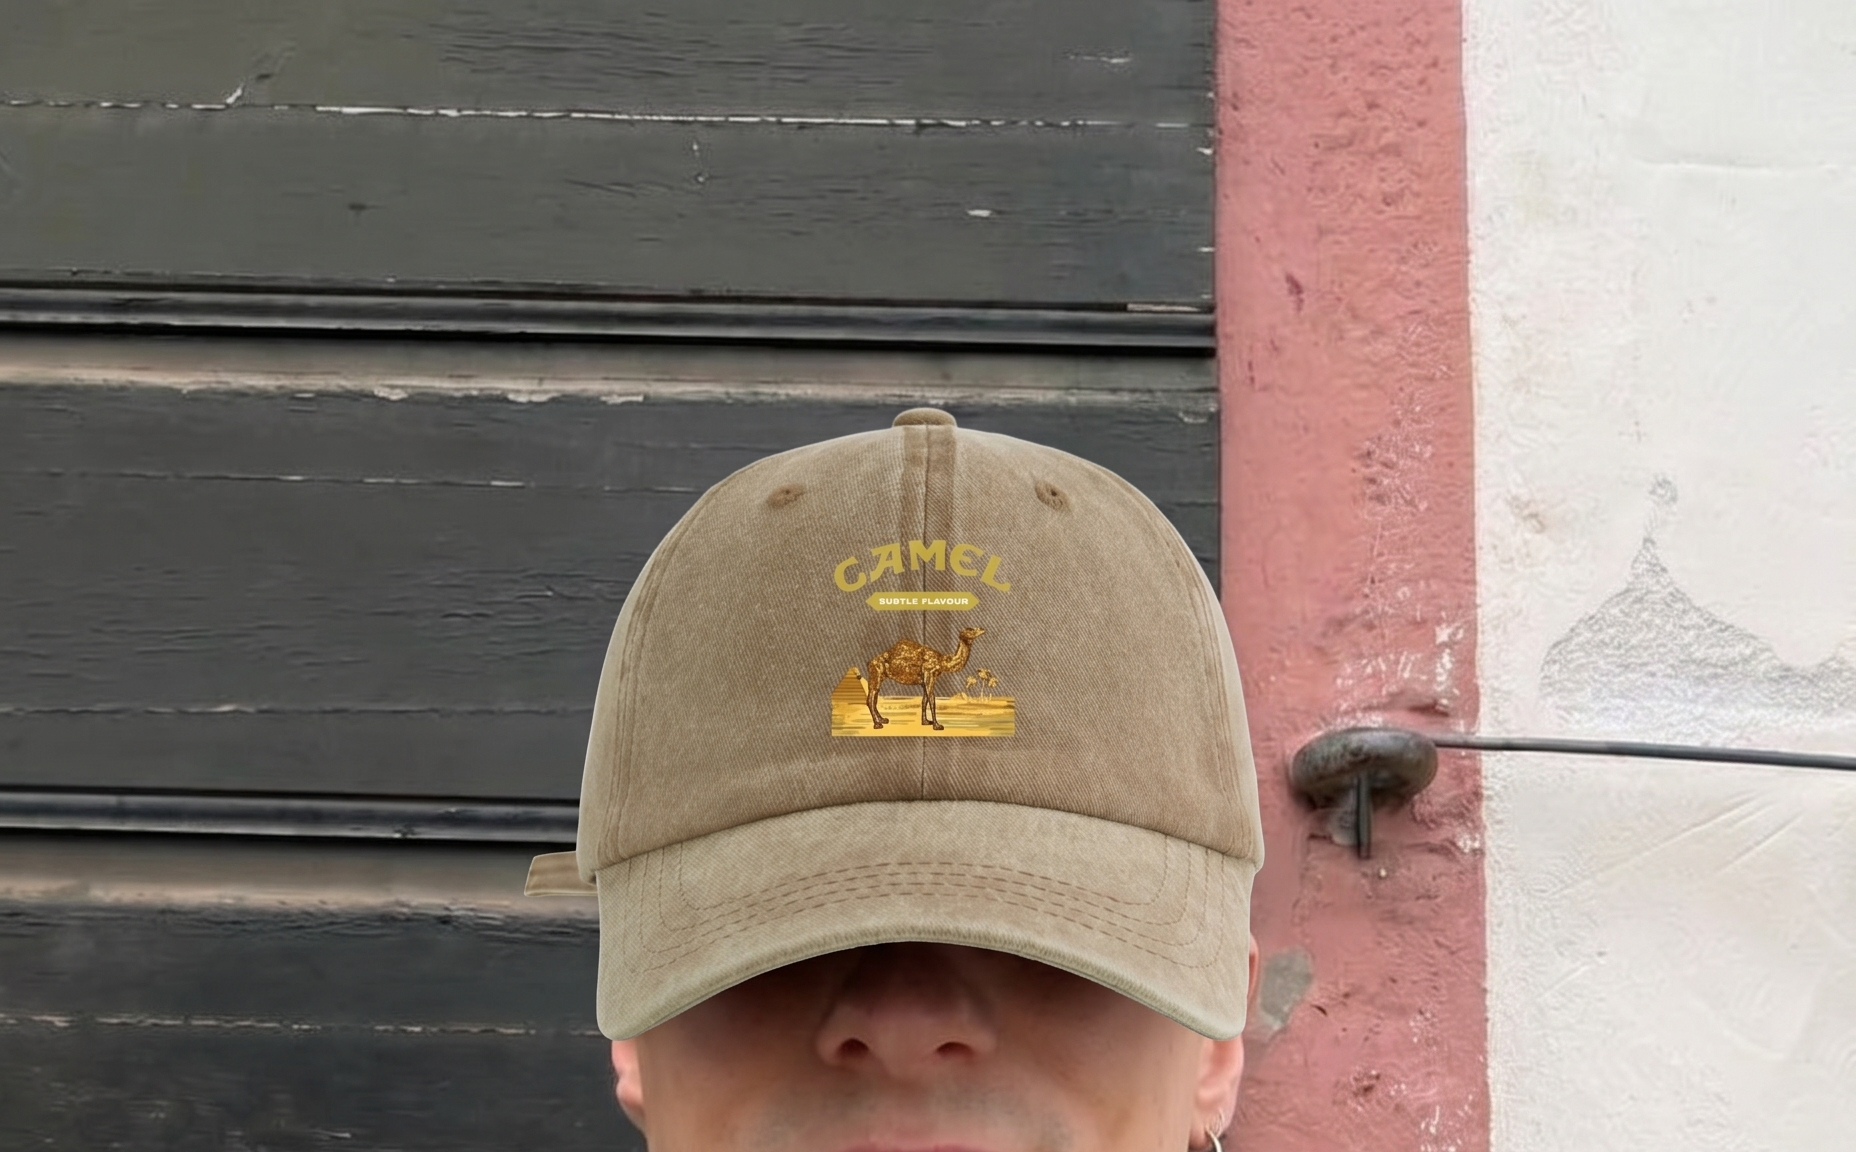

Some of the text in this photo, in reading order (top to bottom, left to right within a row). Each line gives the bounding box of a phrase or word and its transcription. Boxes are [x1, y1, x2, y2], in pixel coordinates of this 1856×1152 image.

[834, 540, 1011, 592] CAMEL
[879, 597, 969, 605] SUBTLE FLAVOUR
